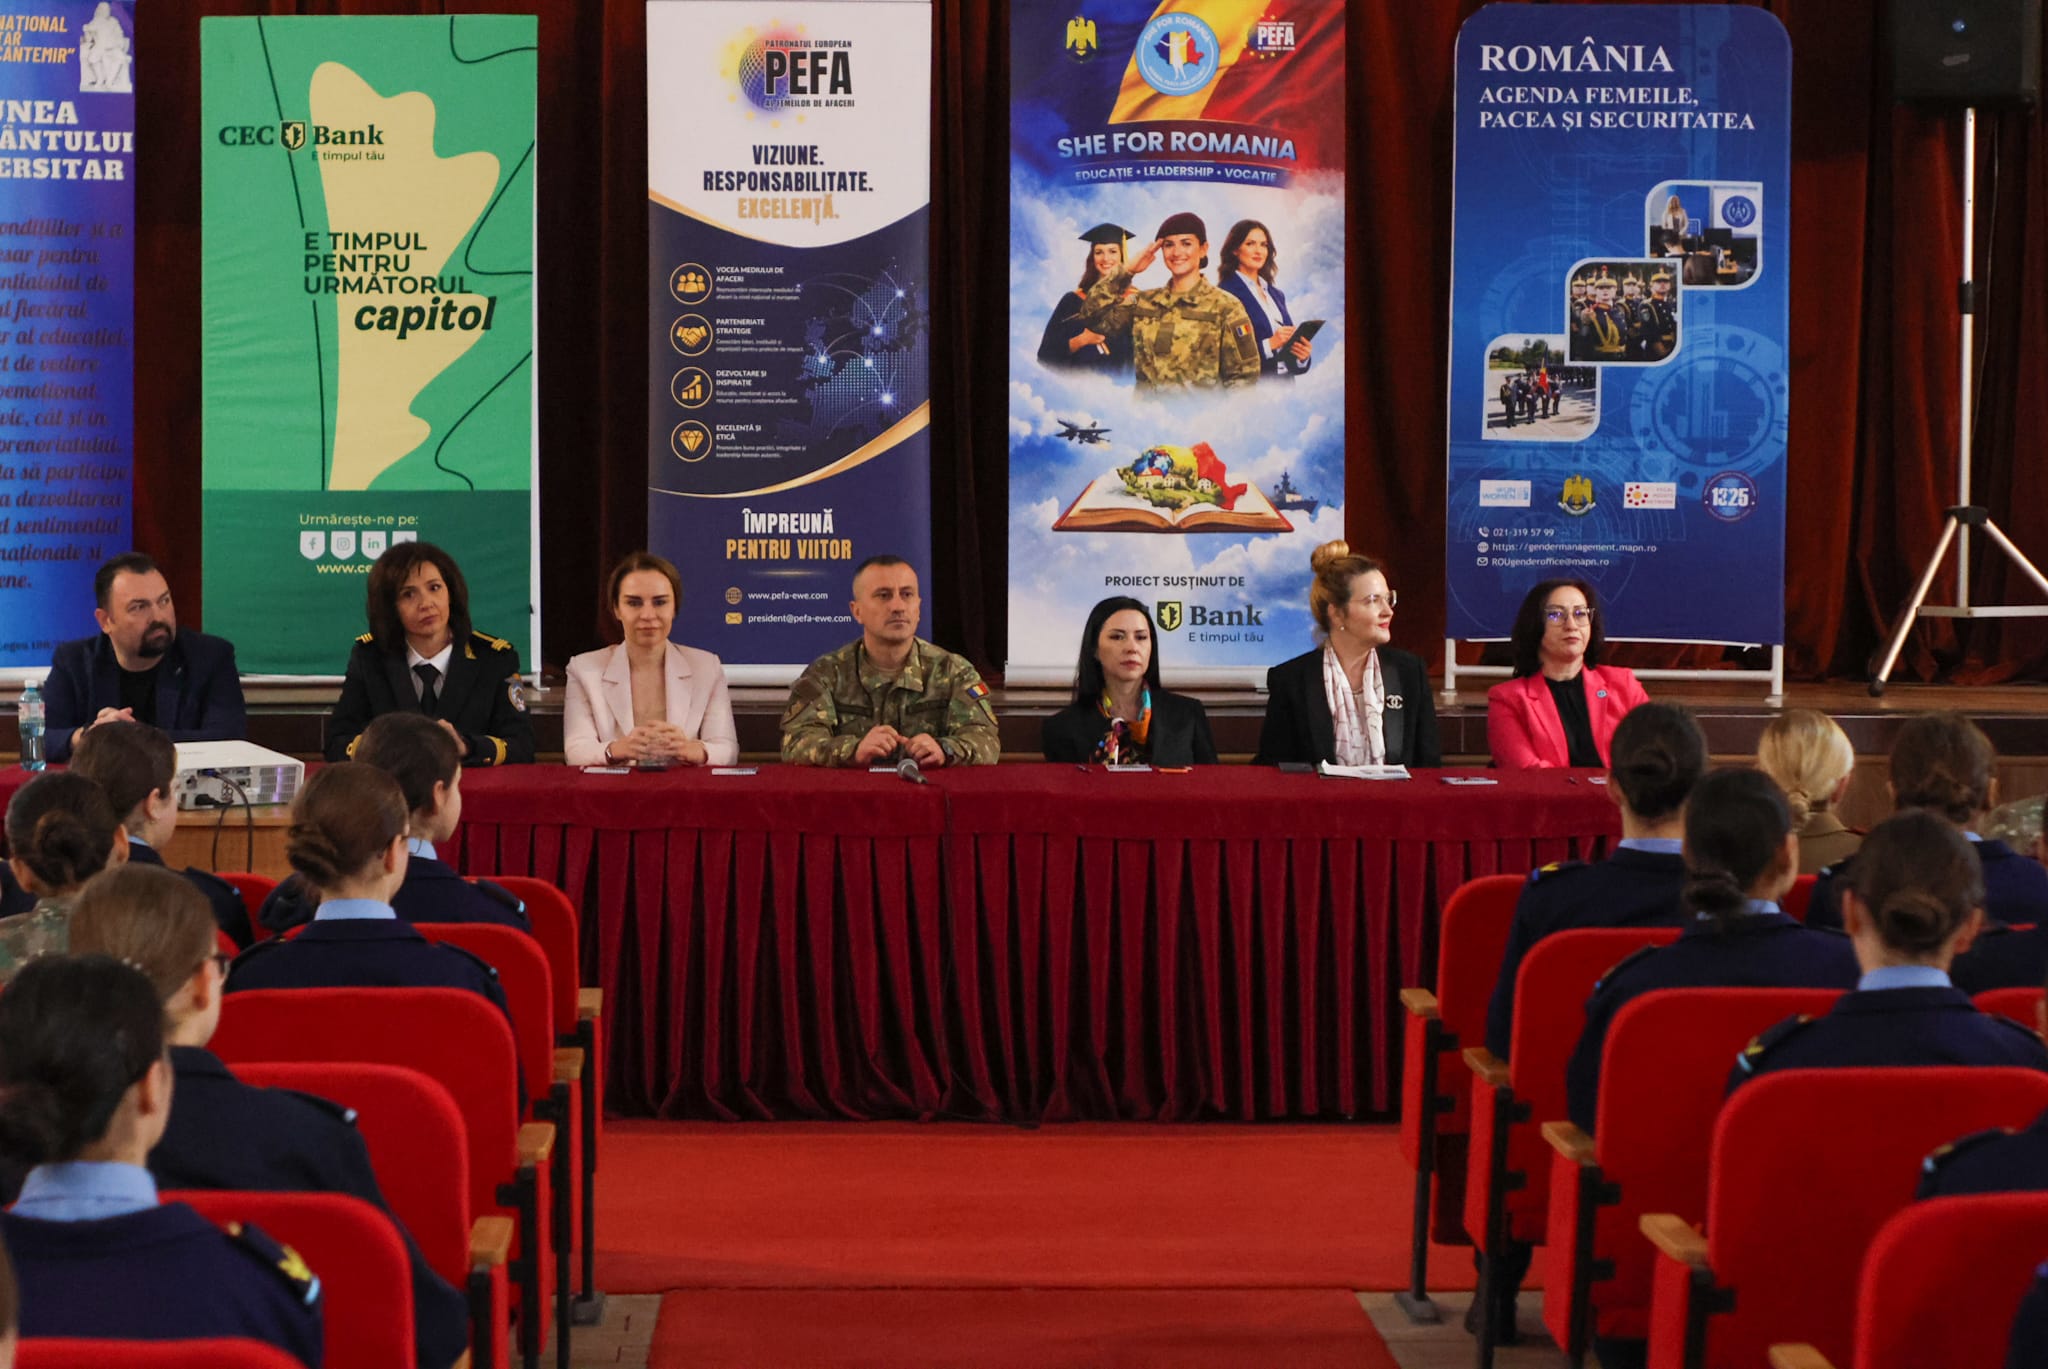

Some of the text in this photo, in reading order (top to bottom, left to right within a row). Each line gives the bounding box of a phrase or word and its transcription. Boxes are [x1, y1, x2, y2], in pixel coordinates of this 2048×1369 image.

[765, 40, 852, 48] PATRONATUL EUROPEAN
[1257, 26, 1295, 46] PEFA
[1479, 36, 1675, 72] ROMÂNIA
[765, 51, 852, 94] PEFA
[825, 99, 855, 107] AFACERI
[1479, 87, 1700, 107] AGENDA FEMEILE,
[0, 100, 78, 124] NEA
[1479, 111, 1756, 132] PACEA ȘI SECURITATEA
[0, 124, 133, 152] ÂNTULUI
[218, 123, 384, 146] CEC Bank
[752, 145, 824, 166] VIZIUNE.
[1057, 131, 1297, 161] SHE FOR ROMANIA
[311, 150, 385, 163] E timpul tău
[703, 171, 874, 192] RESPONSABILITATE.
[1075, 166, 1277, 183] EDUCAȚIE LEADERSHIP VOCAȚIE
[738, 194, 840, 226] EXCELENȚĂ.
[304, 232, 427, 251] E TIMPUL
[304, 254, 410, 272] PENTRU
[716, 266, 784, 274] VOCEA MEDIULUI DE
[304, 272, 472, 294] URMĂTORUL
[716, 275, 744, 283] AFACERI
[354, 296, 497, 340] capitol
[716, 318, 765, 326] PARTENERIATE
[14, 354, 35, 371] de
[1711, 487, 1749, 507] 1325
[300, 513, 419, 528] Urmărește-ne pe:
[742, 507, 834, 534] ÎMPREUNĂ
[1492, 528, 1555, 537] 021-319 57 99
[726, 538, 852, 559] PENTRU VIITOR
[1492, 543, 1657, 553] https://gendermanagement.mapn.ro
[1105, 576, 1245, 591] PROIECT SUSȚINUT DE
[748, 591, 828, 600] www.pefa-ewe.com
[748, 613, 851, 624] president@pefa-ewe.com
[1189, 604, 1264, 627] Bank
[1188, 633, 1196, 642] E
[1200, 631, 1241, 644] timpul
